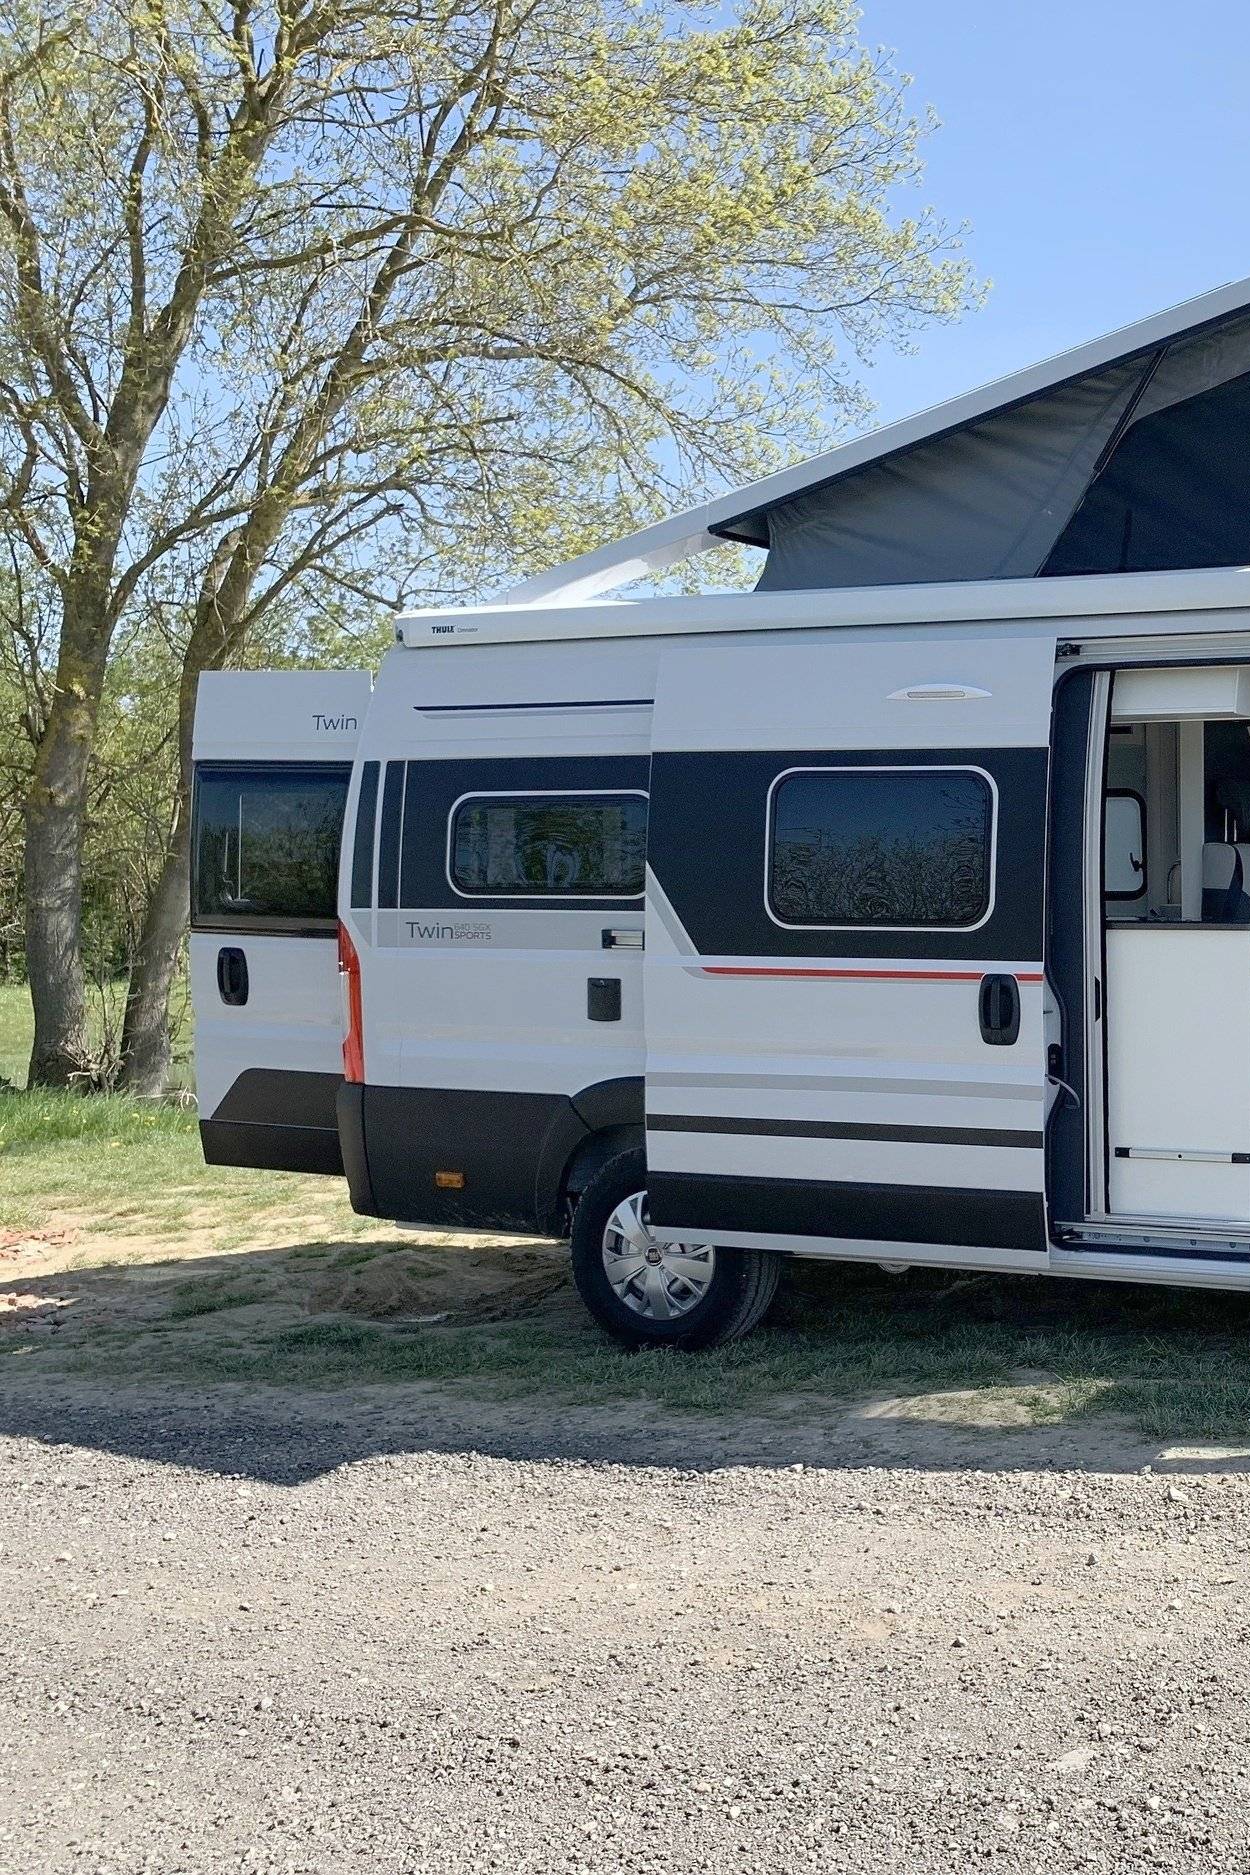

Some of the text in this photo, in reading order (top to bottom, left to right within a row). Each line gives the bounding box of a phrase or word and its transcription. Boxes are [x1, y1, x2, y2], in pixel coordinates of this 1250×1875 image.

[431, 625, 456, 634] THULE
[312, 714, 358, 731] Twin
[405, 921, 454, 939] Twin
[454, 931, 492, 940] SPORTS
